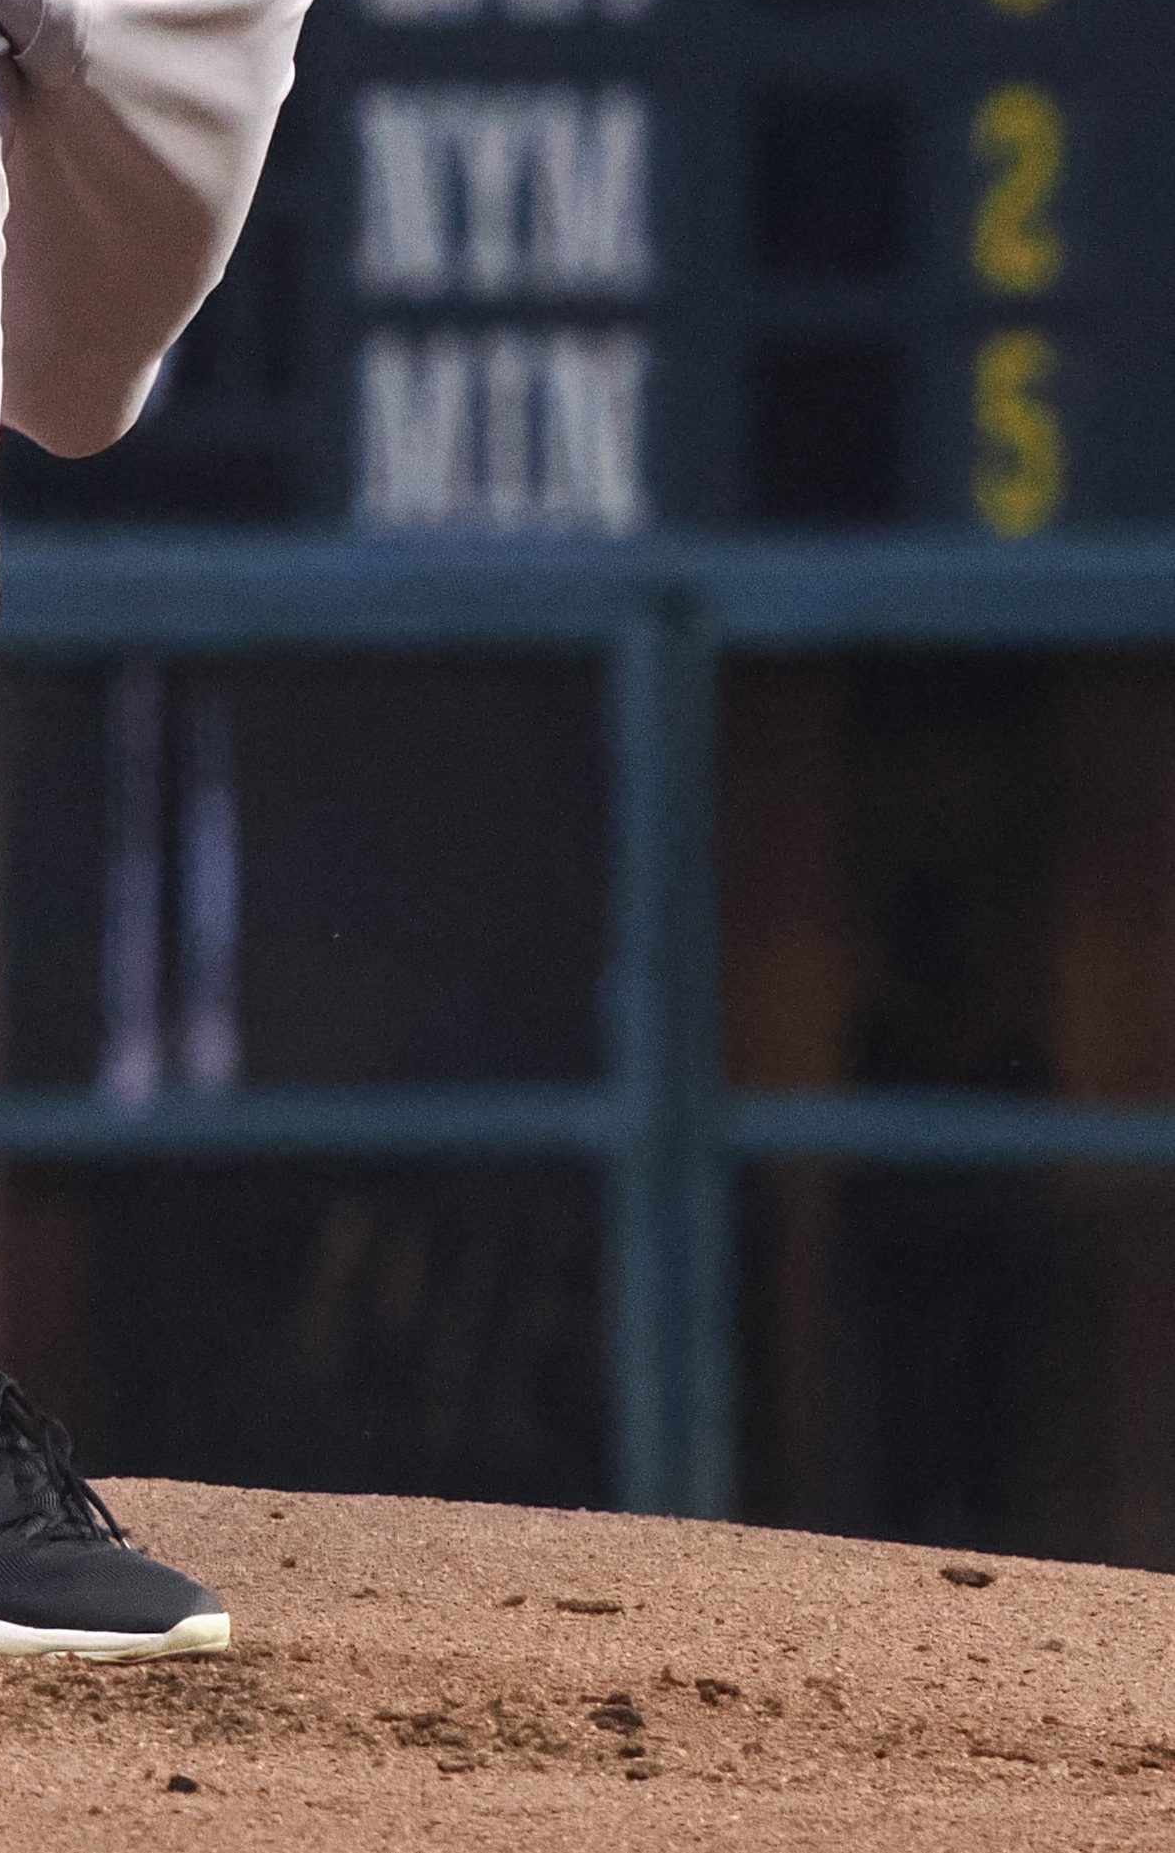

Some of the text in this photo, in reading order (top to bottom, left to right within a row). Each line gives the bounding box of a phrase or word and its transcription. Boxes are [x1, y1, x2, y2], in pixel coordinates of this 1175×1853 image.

[359, 82, 1064, 297] NYM 2
[357, 327, 1064, 539] MIN 5
